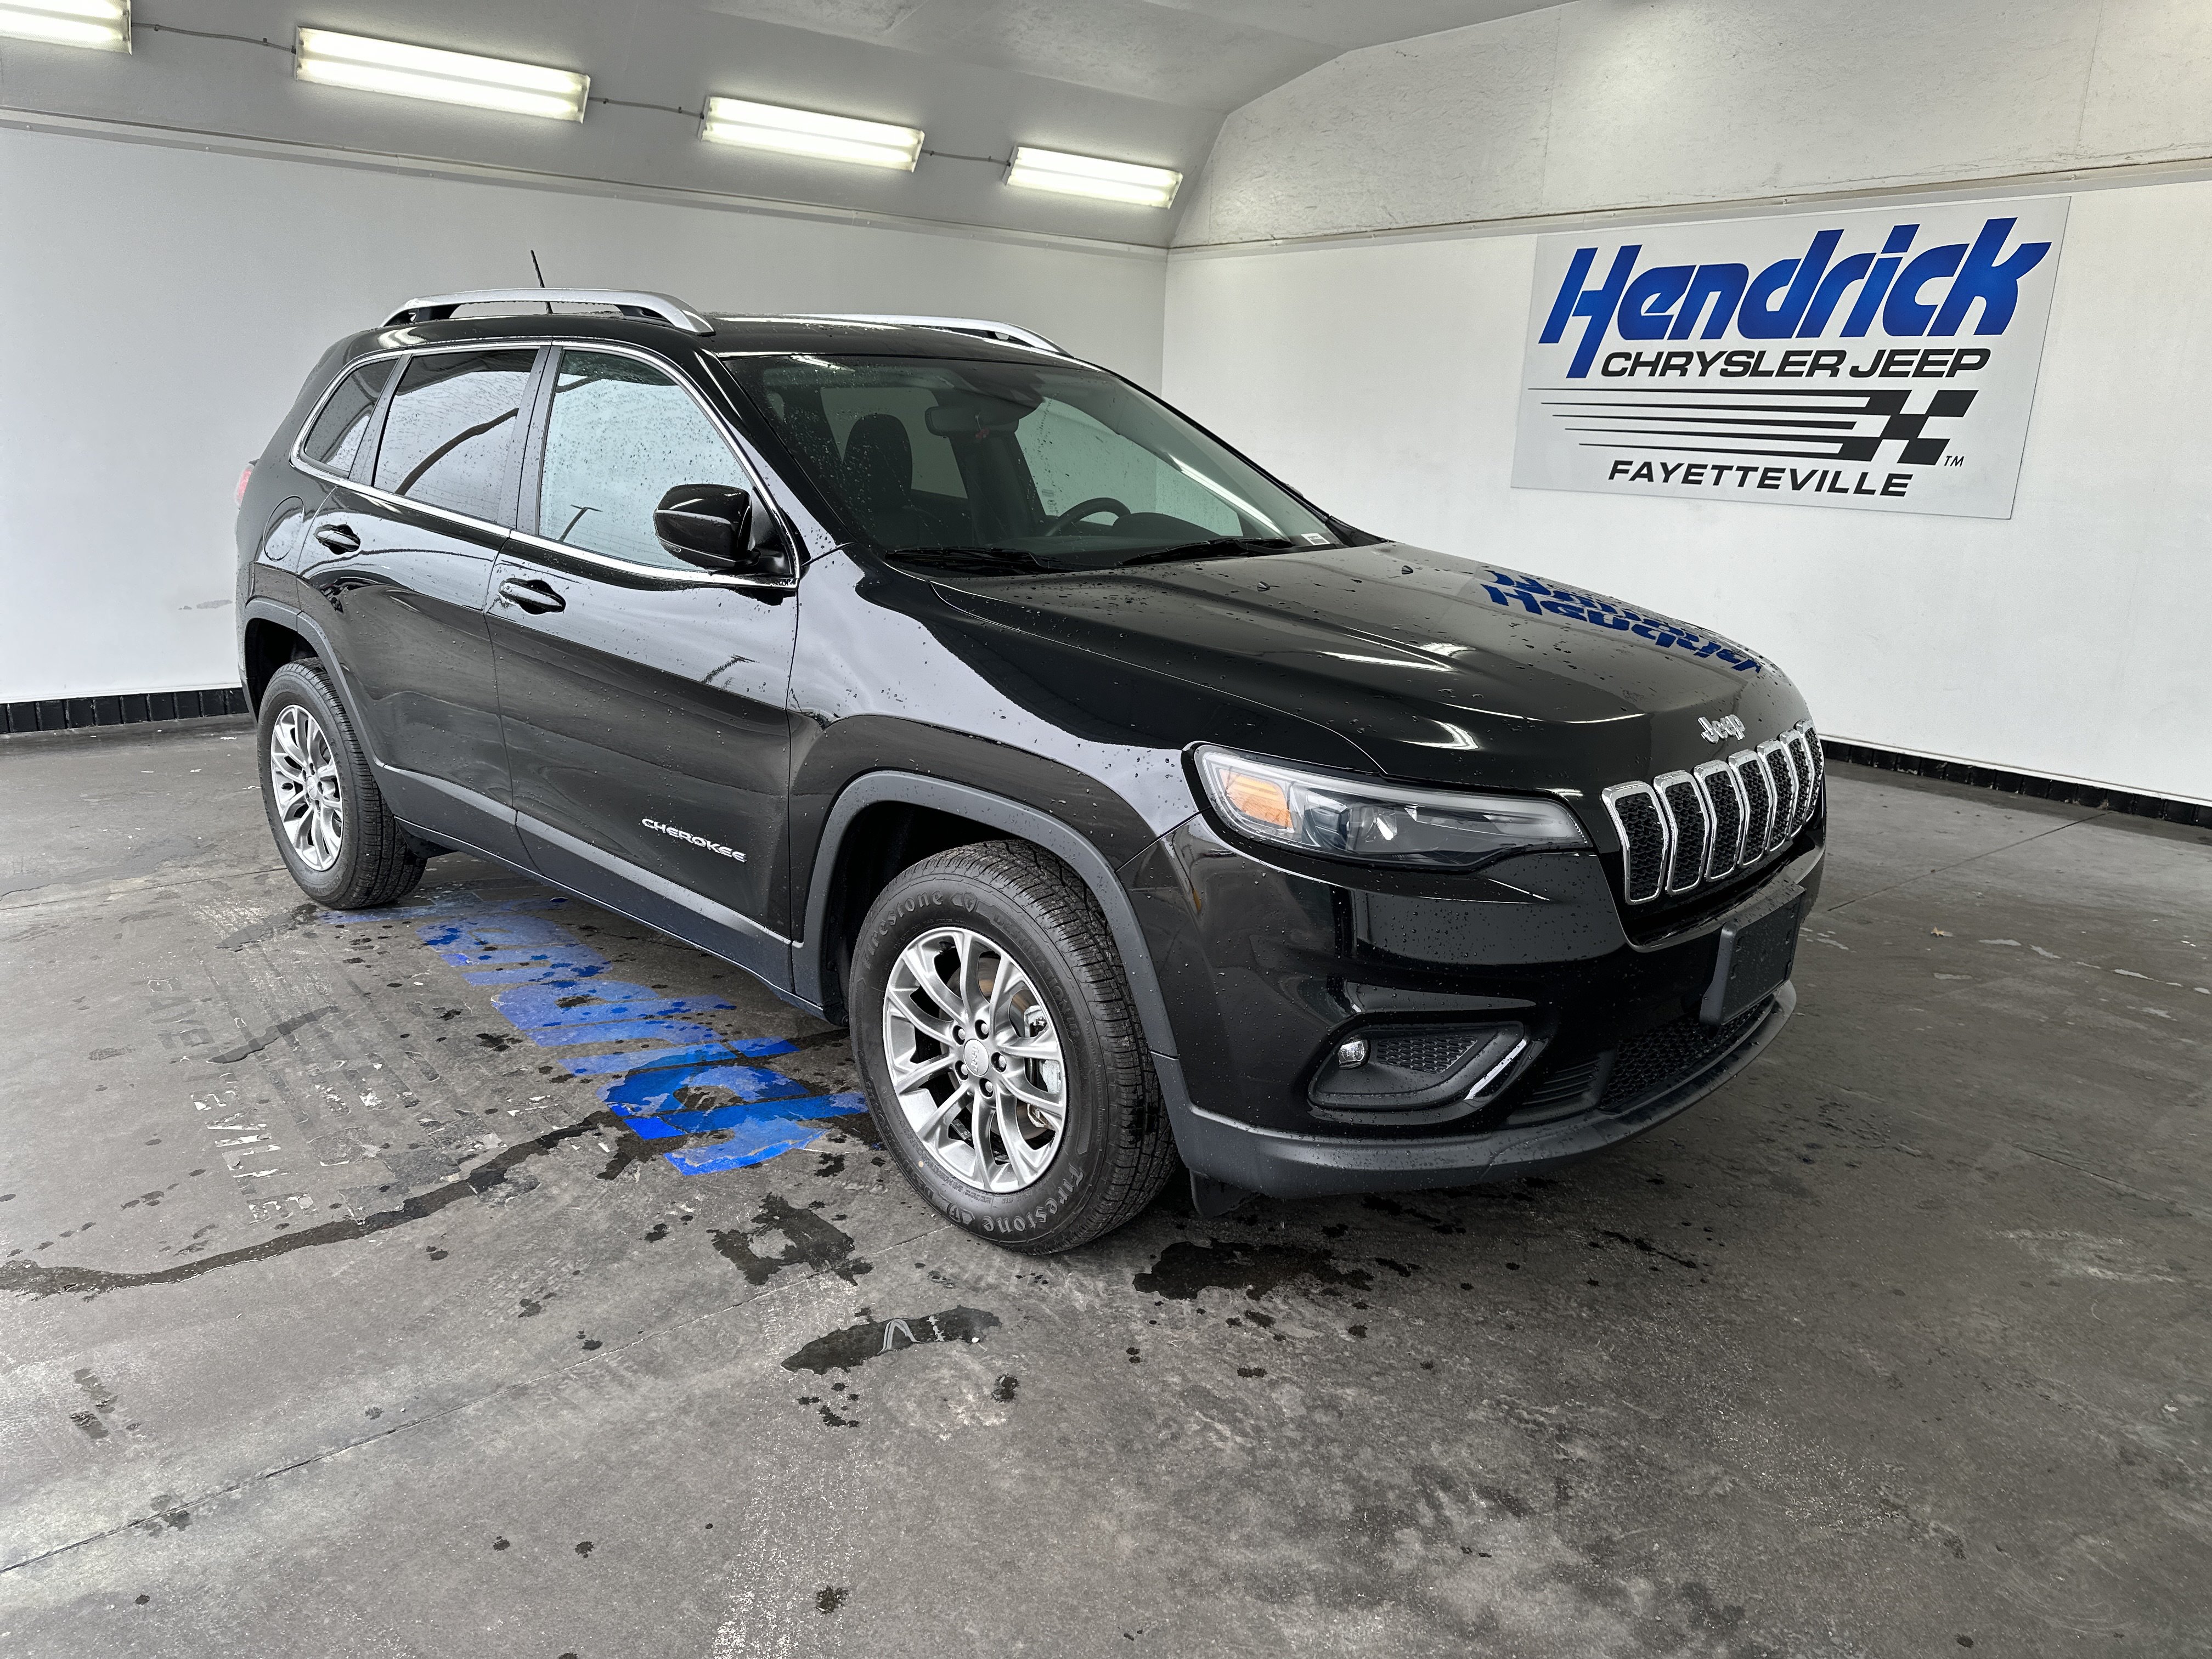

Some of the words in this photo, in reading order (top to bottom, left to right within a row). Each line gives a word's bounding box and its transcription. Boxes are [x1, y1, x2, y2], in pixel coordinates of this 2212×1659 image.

[1538, 217, 2051, 378] Hendrick
[1601, 349, 1847, 377] CHRYSLER
[1849, 348, 1991, 378] JEEP
[1608, 459, 1914, 497] FAYETTEVILLE
[1943, 455, 1965, 467] TM
[1698, 714, 1745, 743] Jeep
[641, 818, 747, 863] CHEROKEE
[861, 890, 944, 972] Firestone
[981, 1162, 1085, 1233] Firestone
